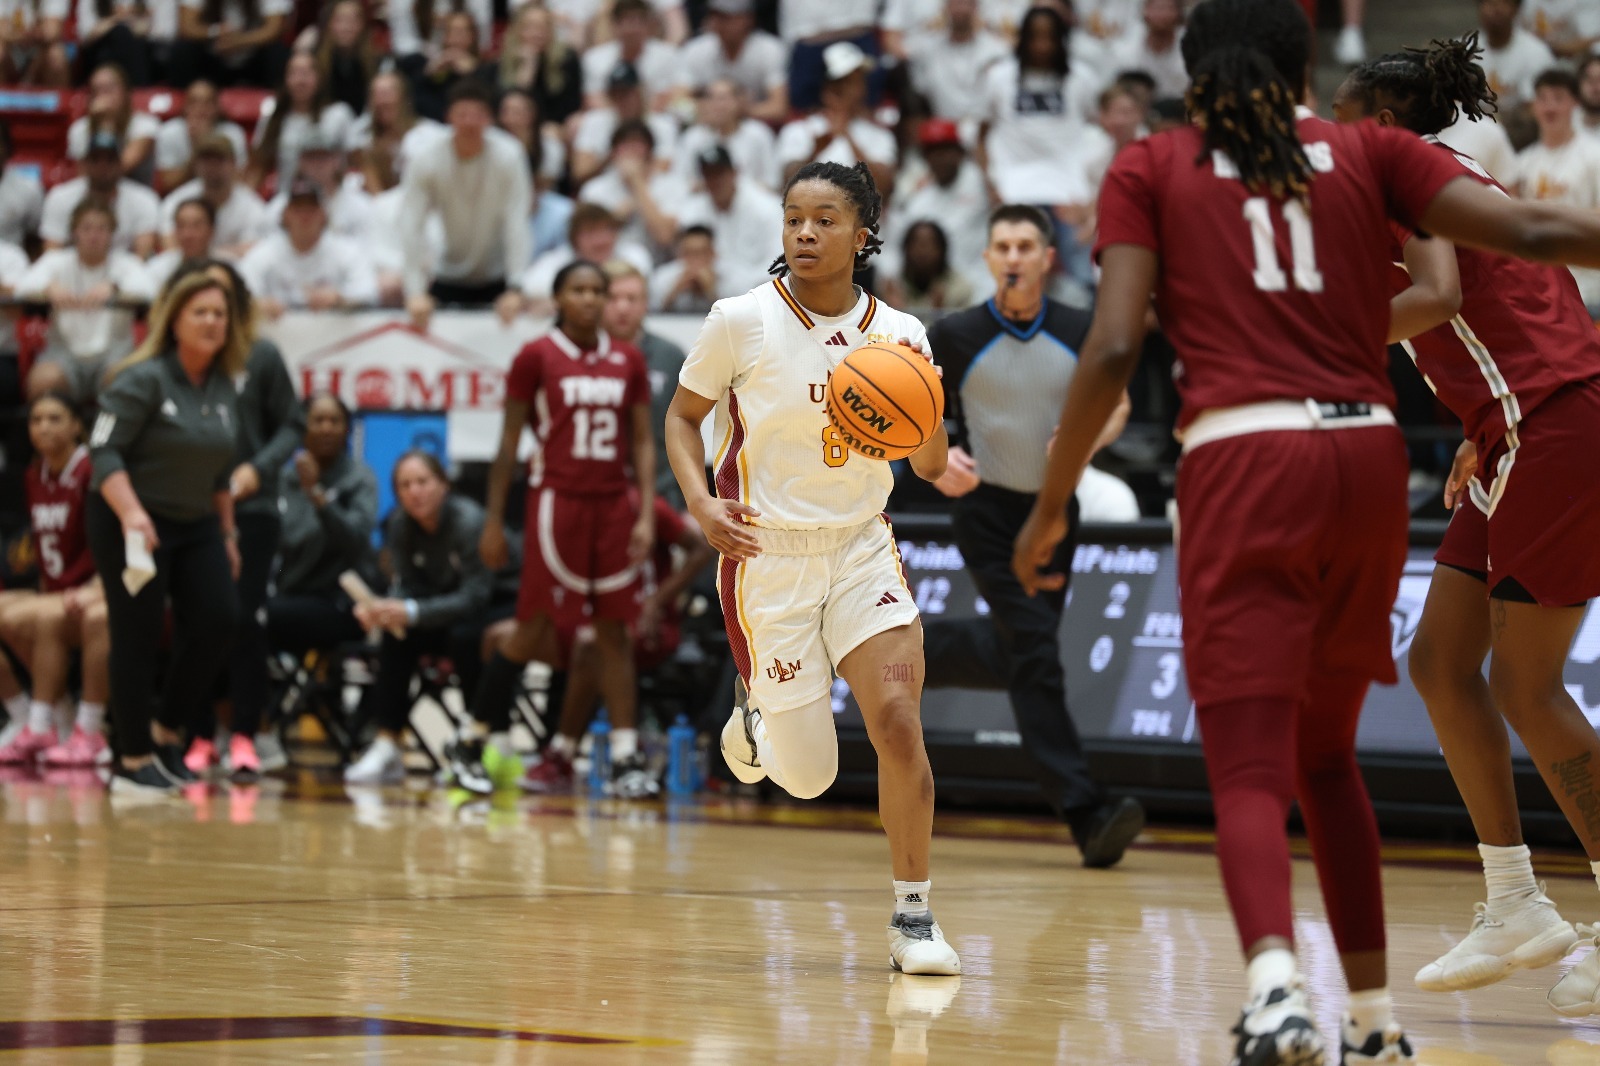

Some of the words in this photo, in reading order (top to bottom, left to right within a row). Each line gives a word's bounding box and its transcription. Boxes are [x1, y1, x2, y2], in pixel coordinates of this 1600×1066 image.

[1242, 197, 1324, 292] 11
[300, 367, 508, 409] HOME
[559, 375, 627, 408] TROY
[841, 386, 894, 434] NCAA
[571, 408, 618, 462] 12
[822, 424, 849, 468] 8
[40, 533, 65, 580] 5
[915, 577, 951, 614] 12
[1103, 580, 1131, 619] 2
[766, 657, 802, 684] ULM
[883, 663, 915, 683] 2001
[1089, 634, 1114, 673] 0
[1150, 652, 1180, 699] 3
